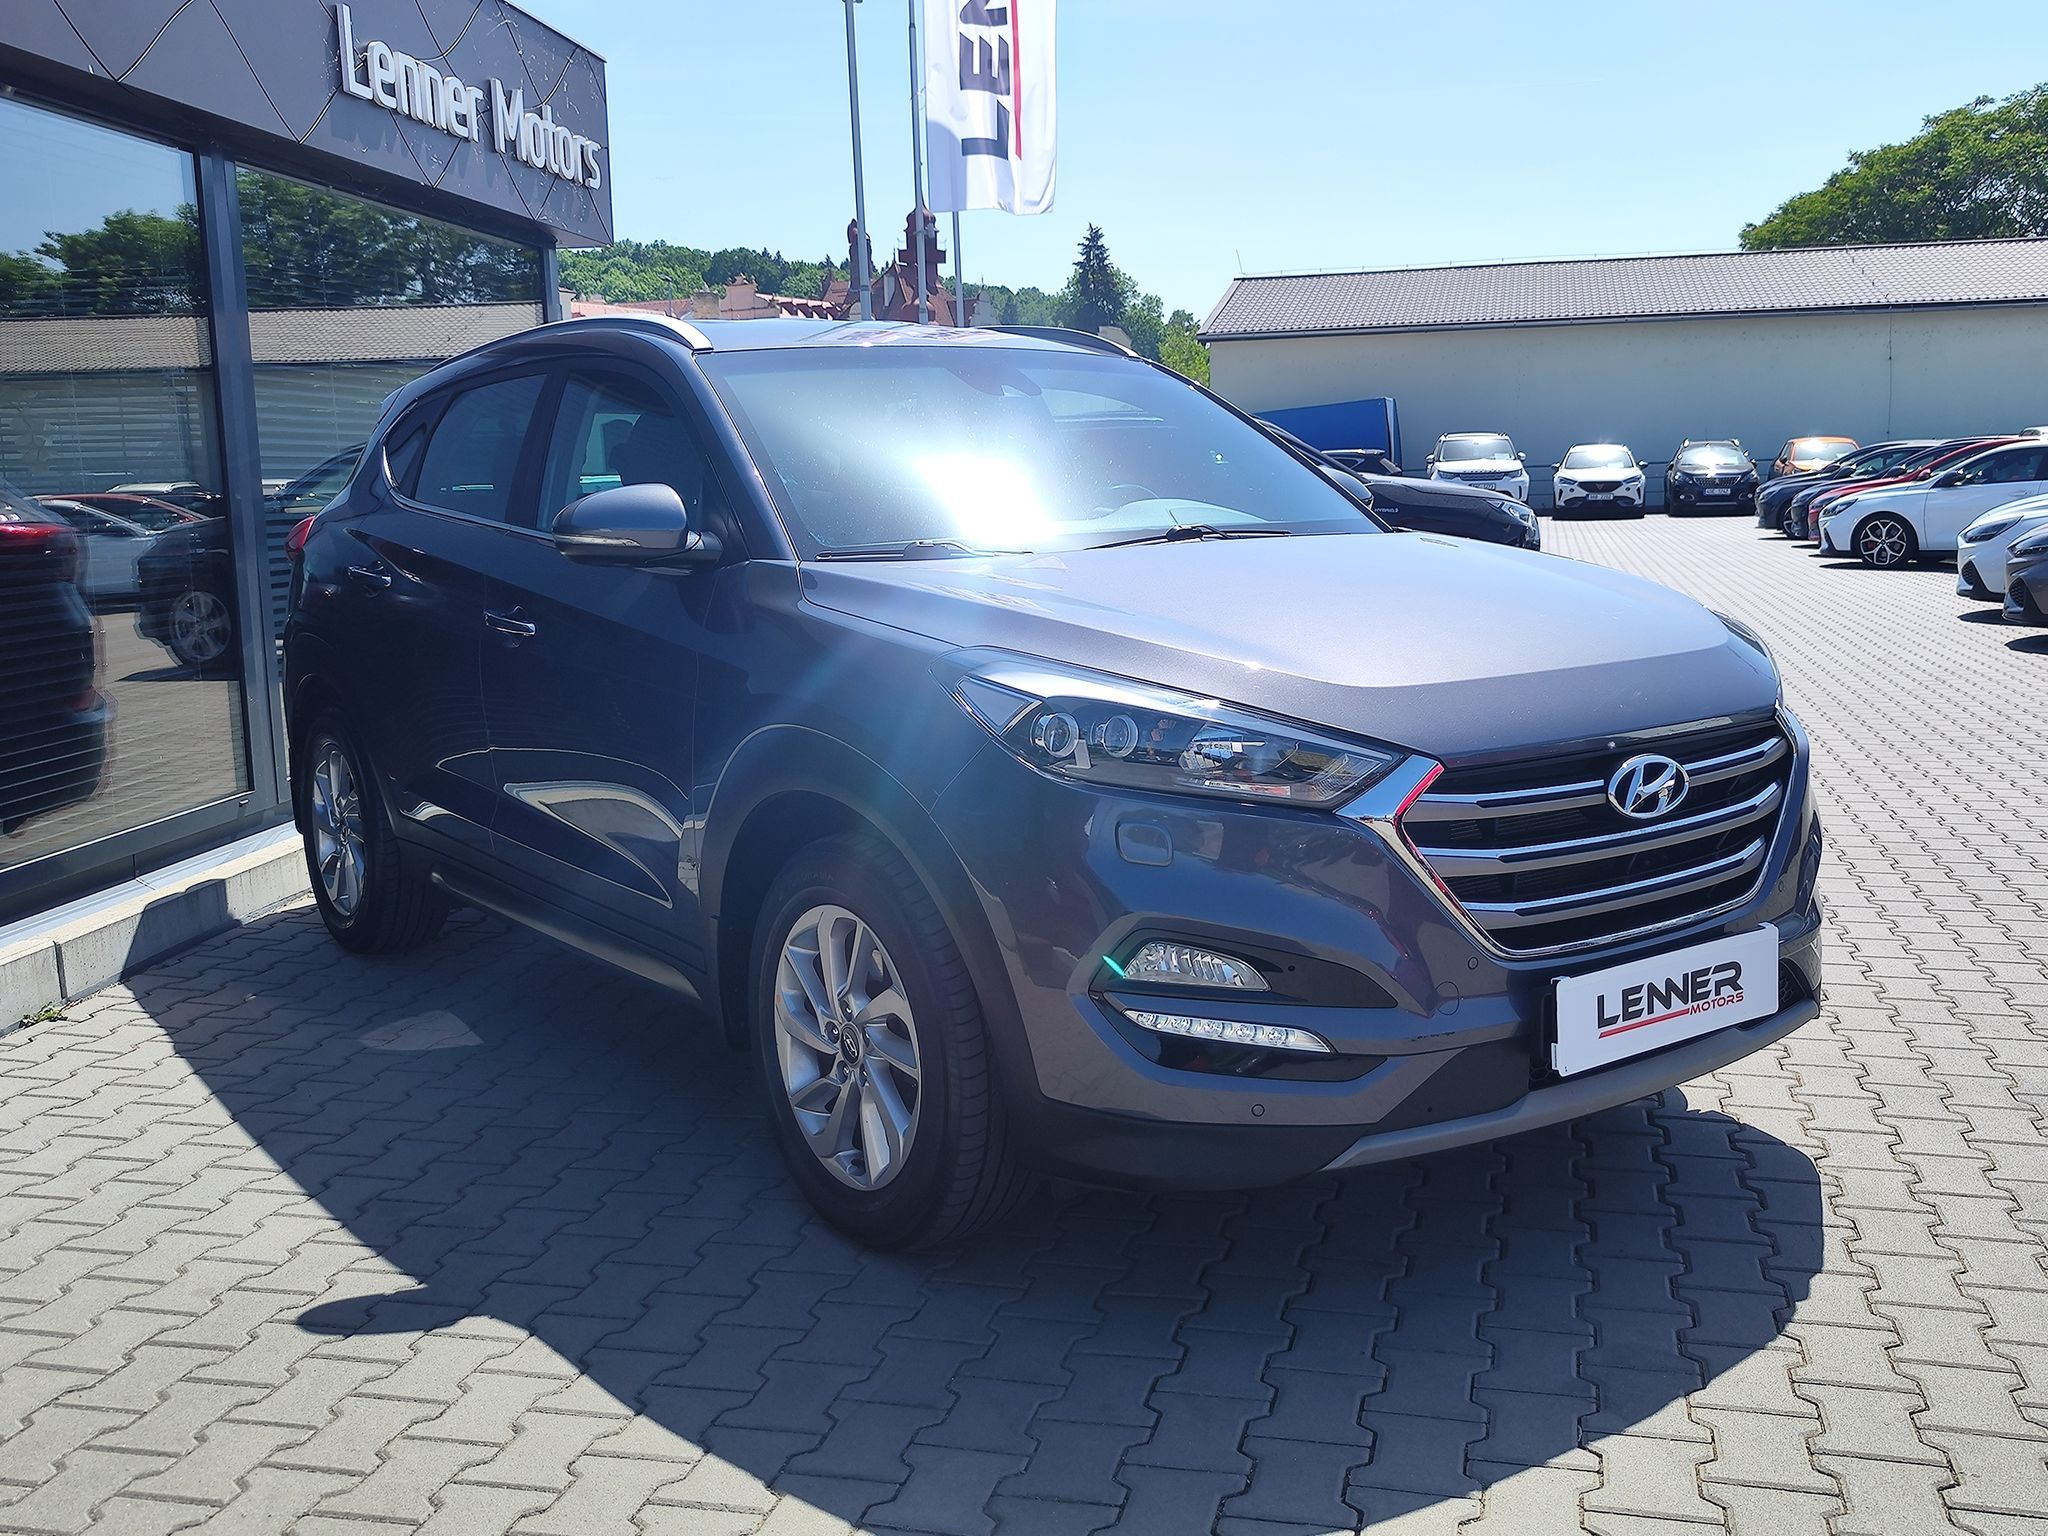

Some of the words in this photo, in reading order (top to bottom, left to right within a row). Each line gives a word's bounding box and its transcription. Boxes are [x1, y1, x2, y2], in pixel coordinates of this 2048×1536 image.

[336, 3, 484, 142] Lenner
[490, 77, 602, 190] Motors
[1597, 960, 1743, 1029] LENNER
[1690, 991, 1744, 1015] MOTORS
